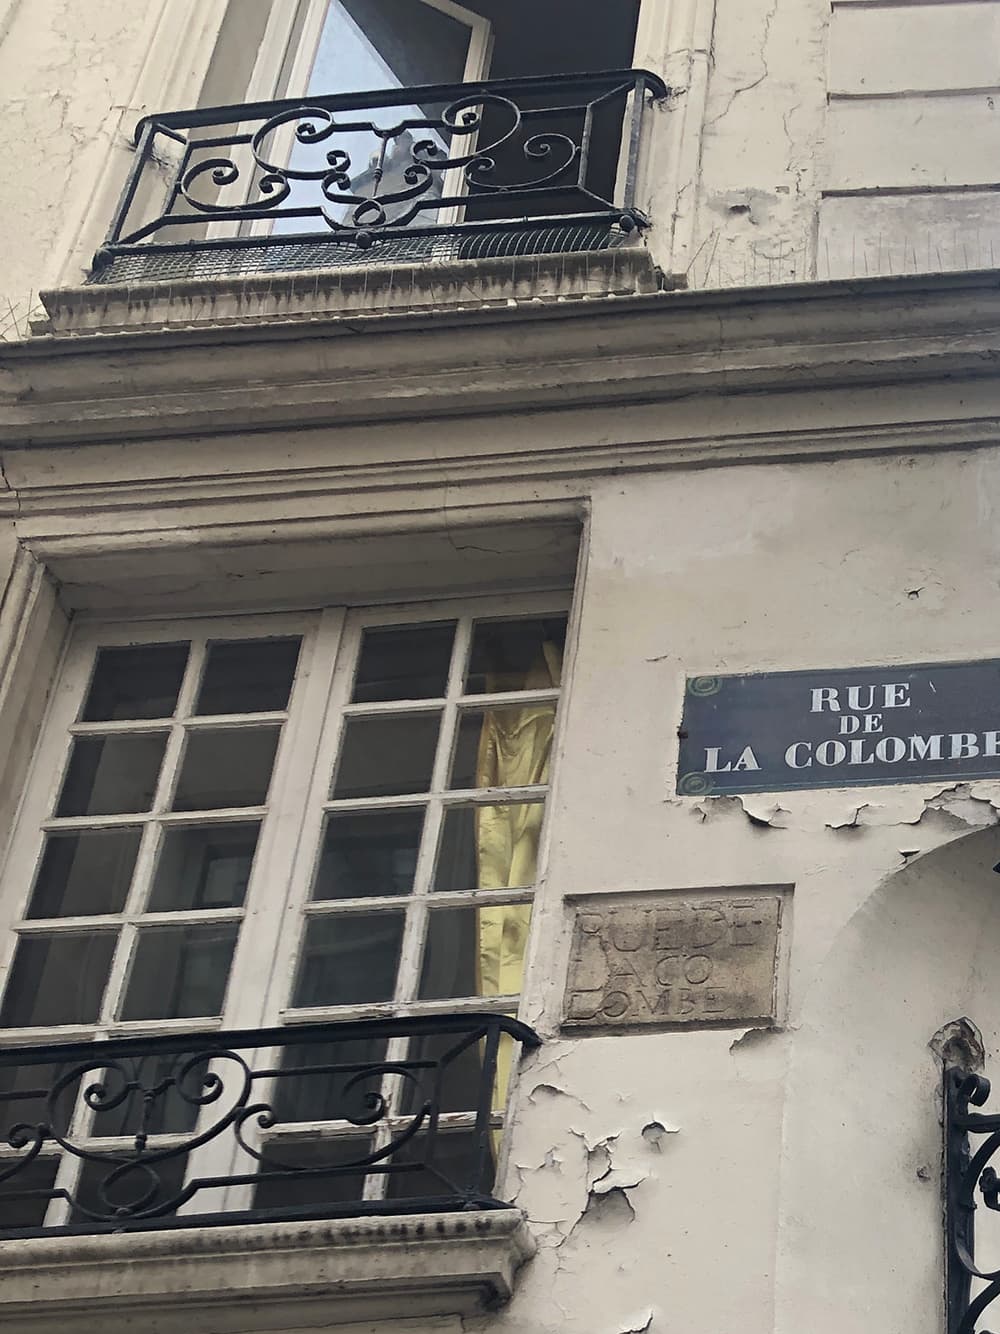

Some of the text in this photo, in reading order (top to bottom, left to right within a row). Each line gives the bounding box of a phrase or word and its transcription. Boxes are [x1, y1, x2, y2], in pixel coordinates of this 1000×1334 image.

[810, 682, 912, 713] RUE
[838, 713, 883, 735] DE
[703, 746, 762, 773] LA
[654, 954, 714, 987] CO
[566, 986, 731, 1021] LOMBE
